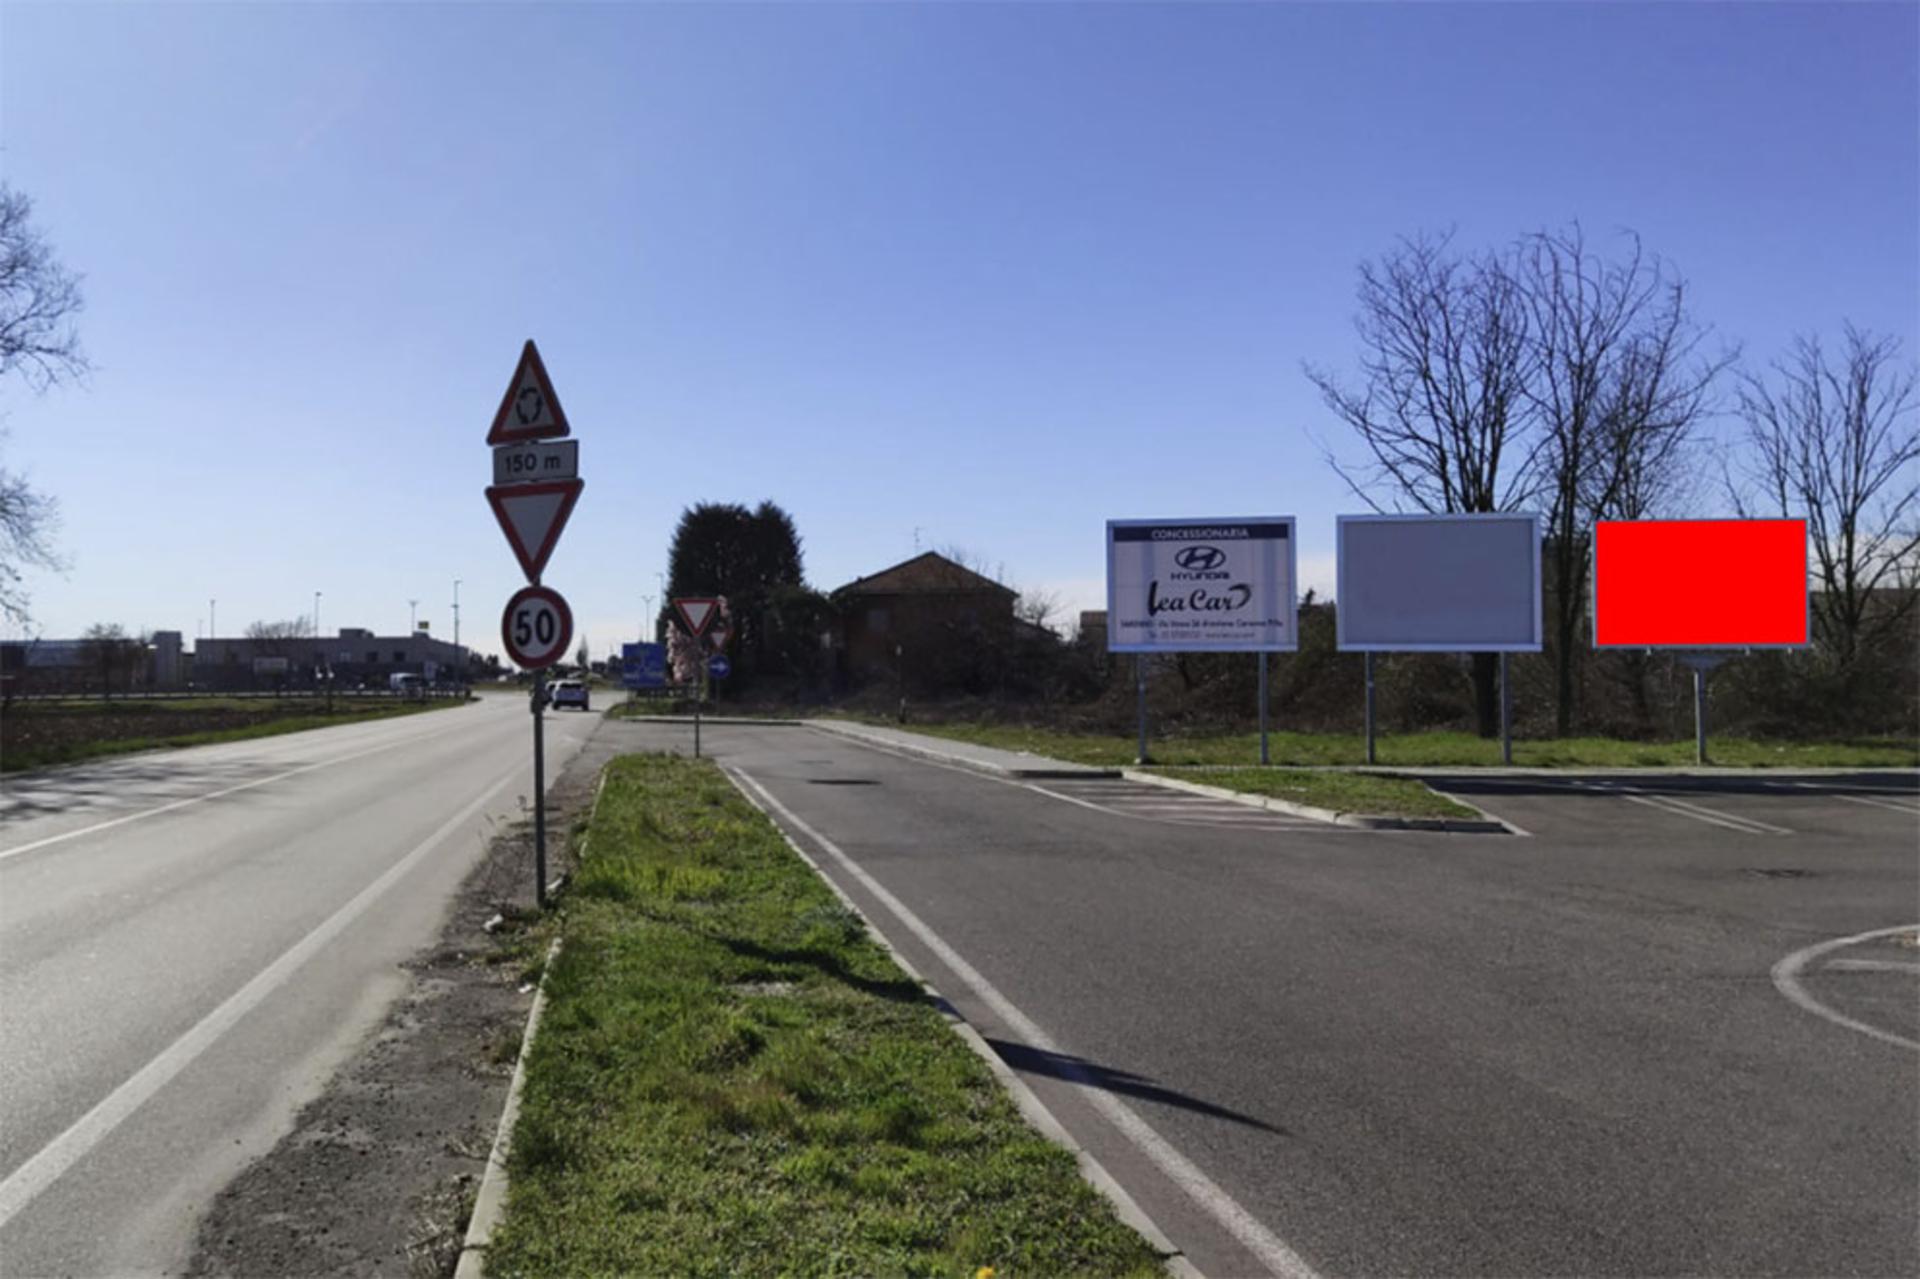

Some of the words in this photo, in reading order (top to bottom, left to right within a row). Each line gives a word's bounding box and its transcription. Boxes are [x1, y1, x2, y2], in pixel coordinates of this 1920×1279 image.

[506, 453, 537, 473] 150
[544, 455, 561, 470] m
[1151, 528, 1249, 540] CONCESSIONARIA
[1170, 572, 1230, 580] HYUNDAI
[515, 609, 555, 647] 50
